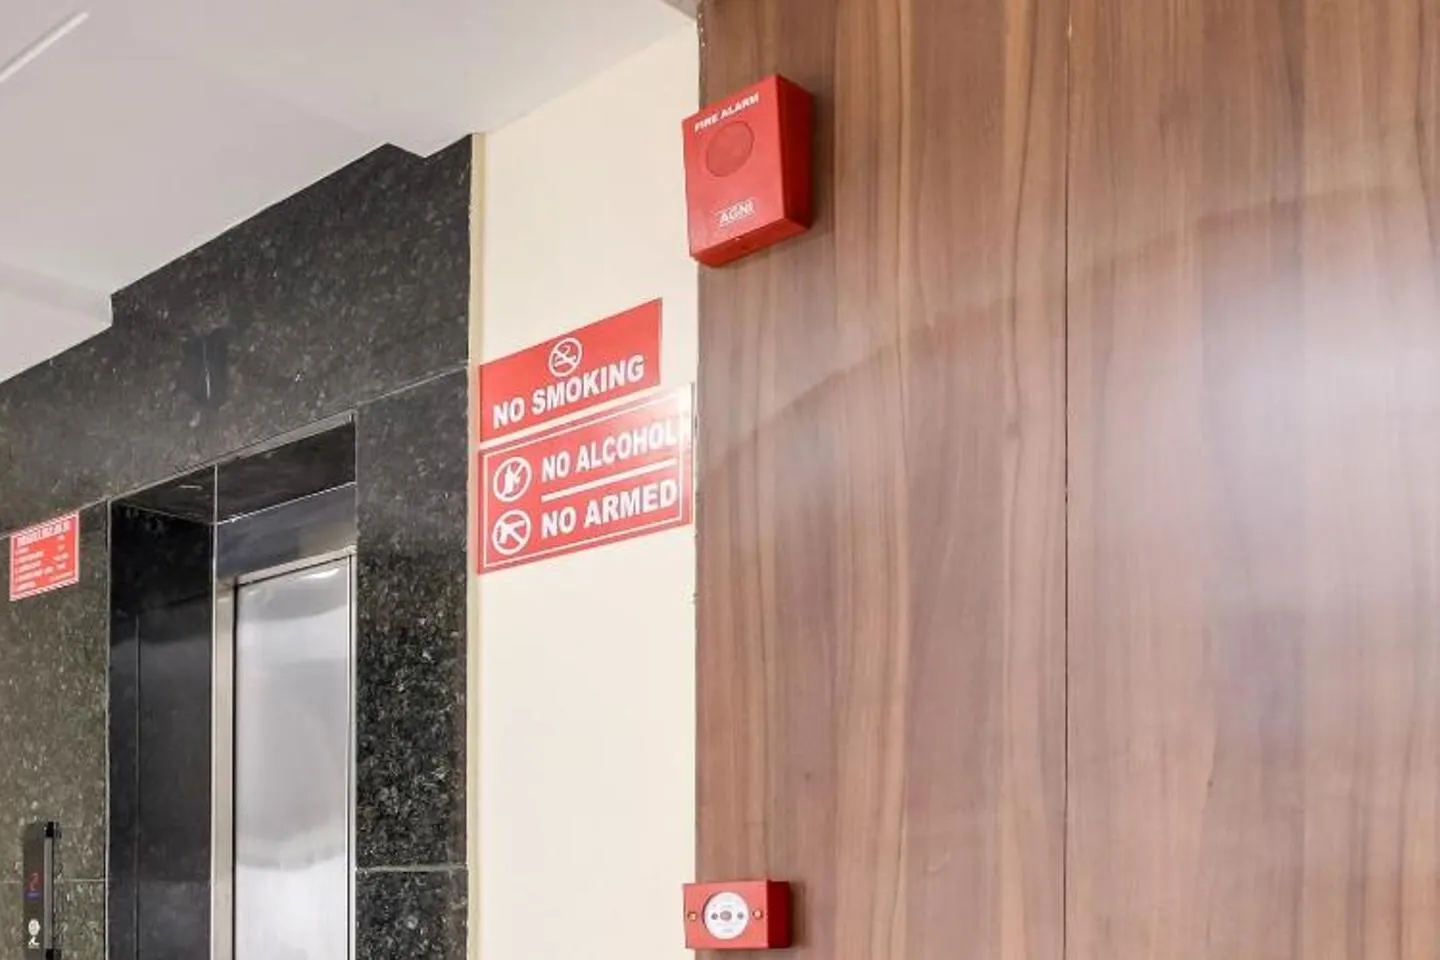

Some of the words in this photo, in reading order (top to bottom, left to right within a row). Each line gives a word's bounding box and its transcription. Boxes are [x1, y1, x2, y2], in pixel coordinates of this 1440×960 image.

[694, 110, 720, 133] FIRE
[720, 91, 760, 120] ALARM
[492, 397, 525, 430] NO
[531, 354, 645, 416] SMOKING
[541, 451, 571, 482] NO
[576, 418, 679, 473] ALCOHOL
[541, 506, 577, 539] NO
[584, 478, 678, 529] ARMED
